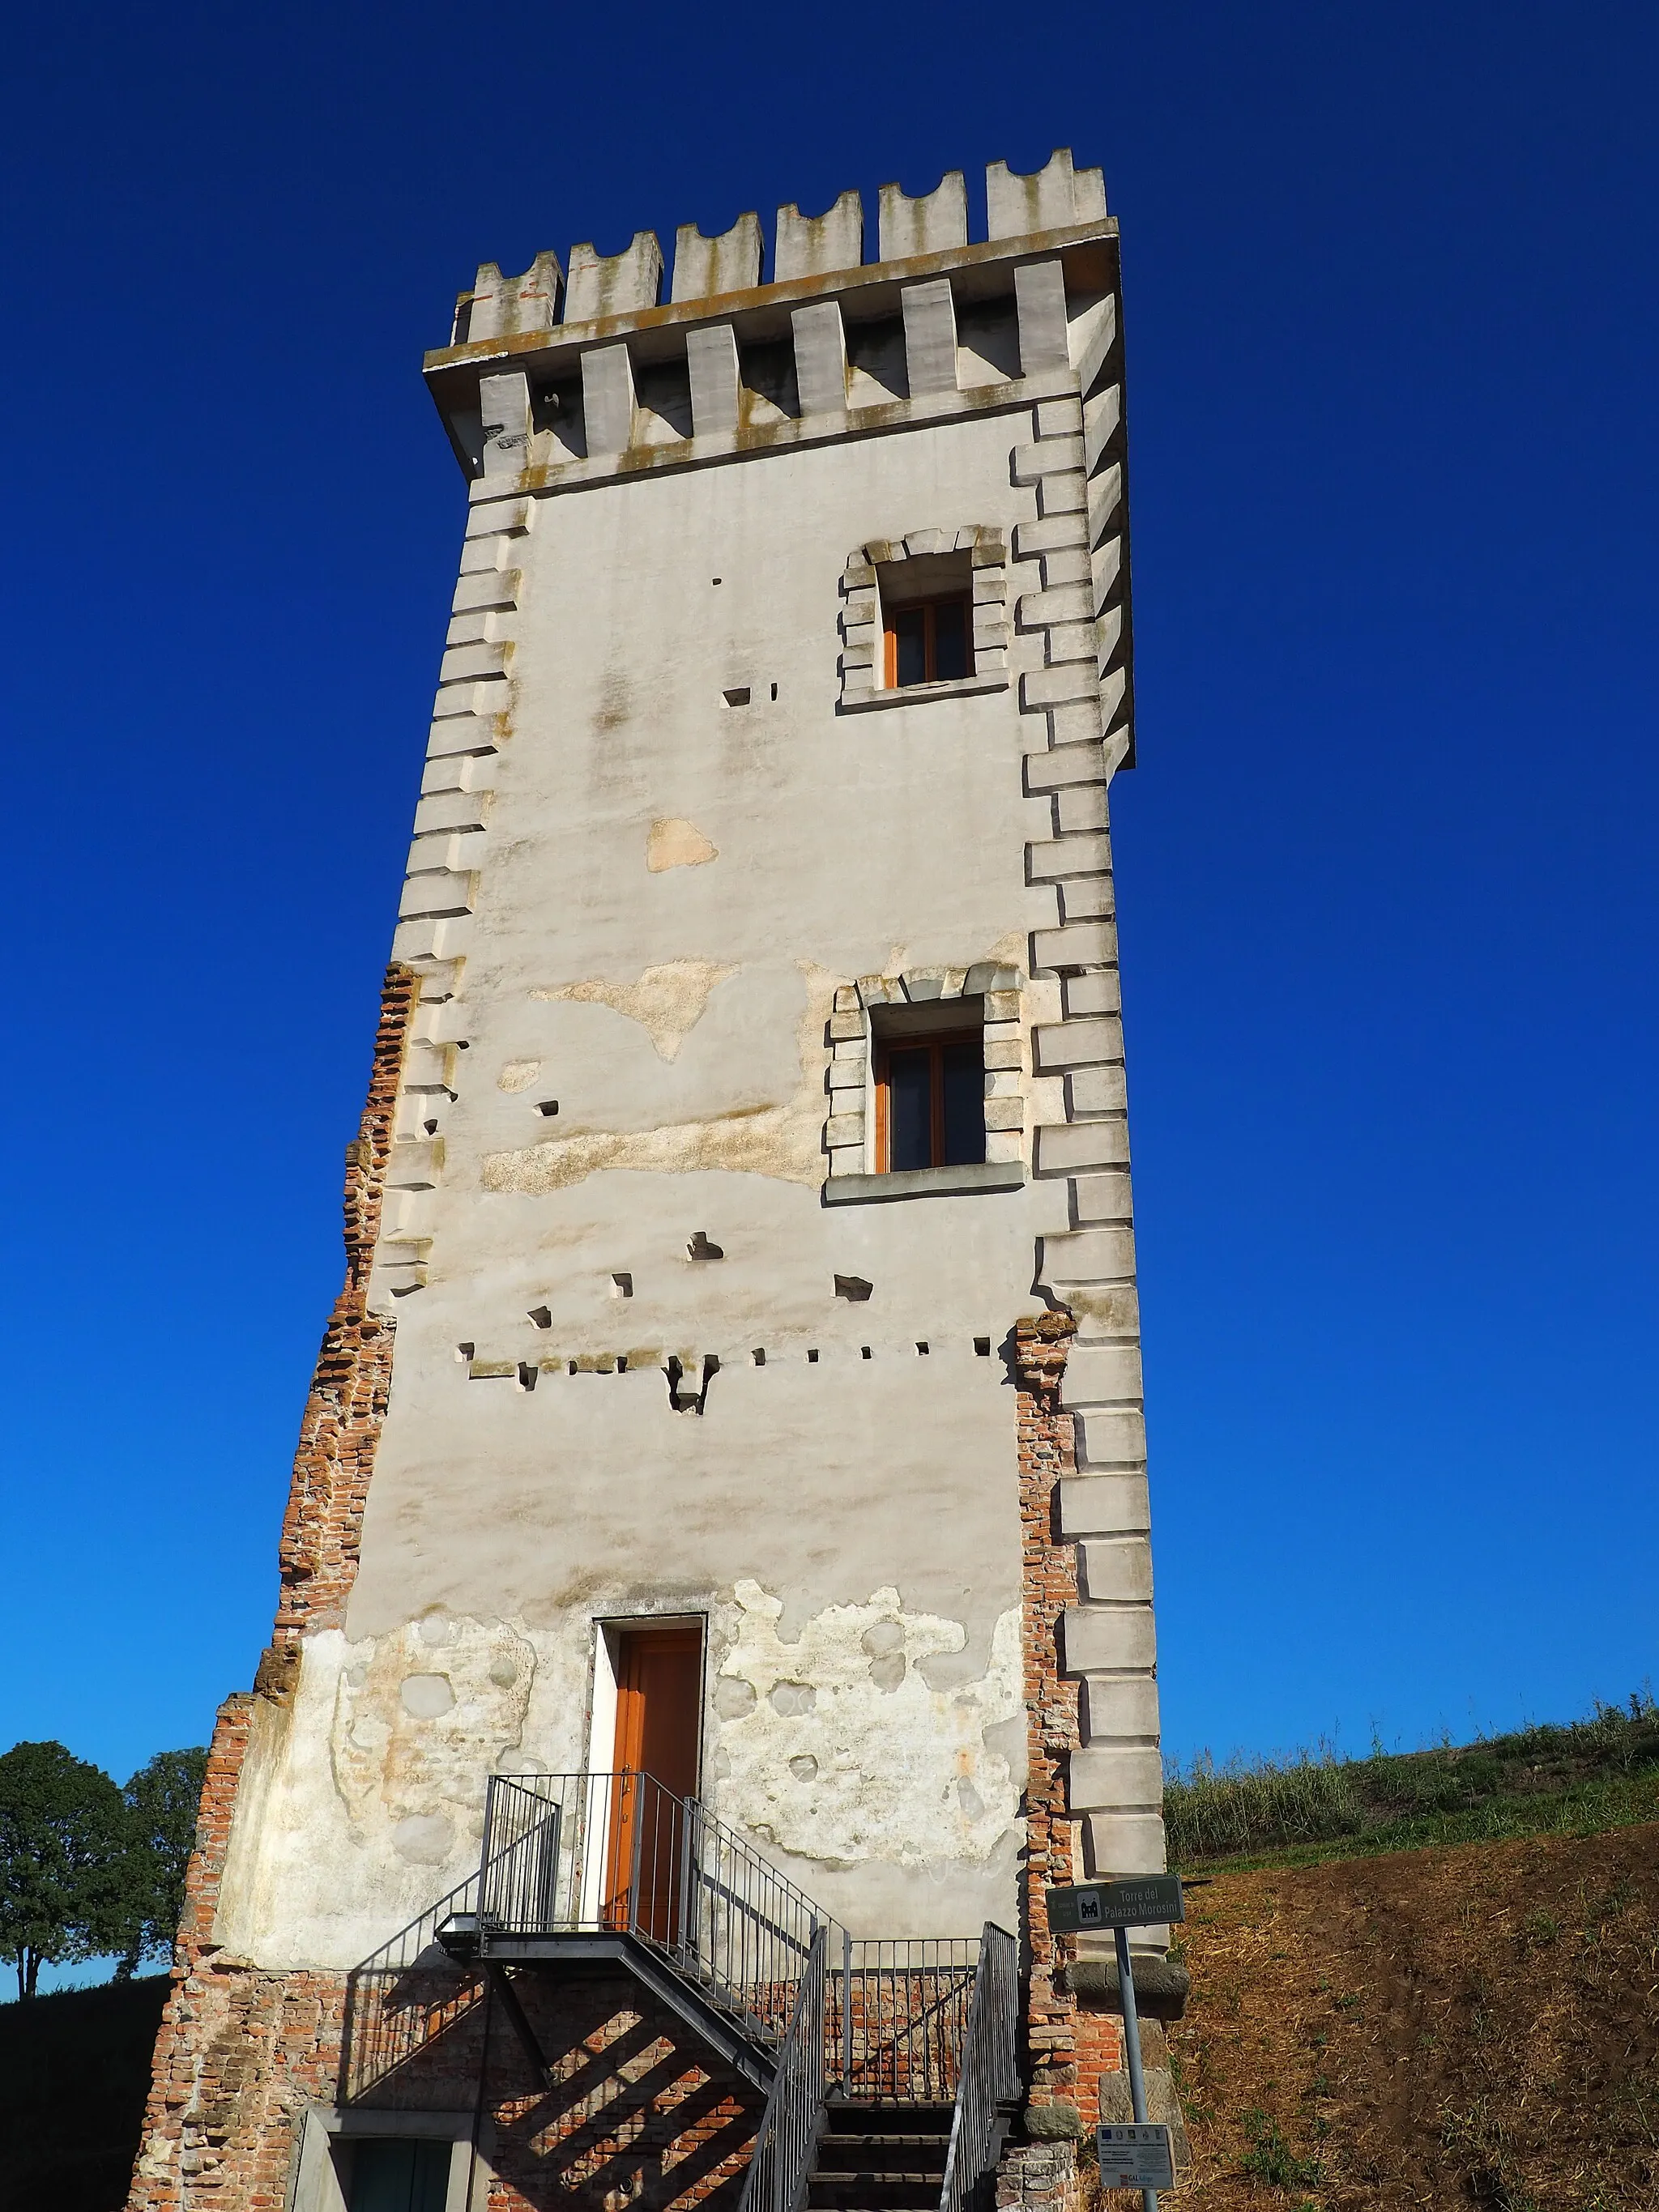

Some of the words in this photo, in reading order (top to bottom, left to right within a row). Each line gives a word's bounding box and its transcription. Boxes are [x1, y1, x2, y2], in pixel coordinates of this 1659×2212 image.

[1119, 1890, 1142, 1903] Torre
[1145, 1886, 1158, 1900] del
[1104, 1905, 1137, 1918] Palazzo
[1138, 1900, 1177, 1916] Morosini
